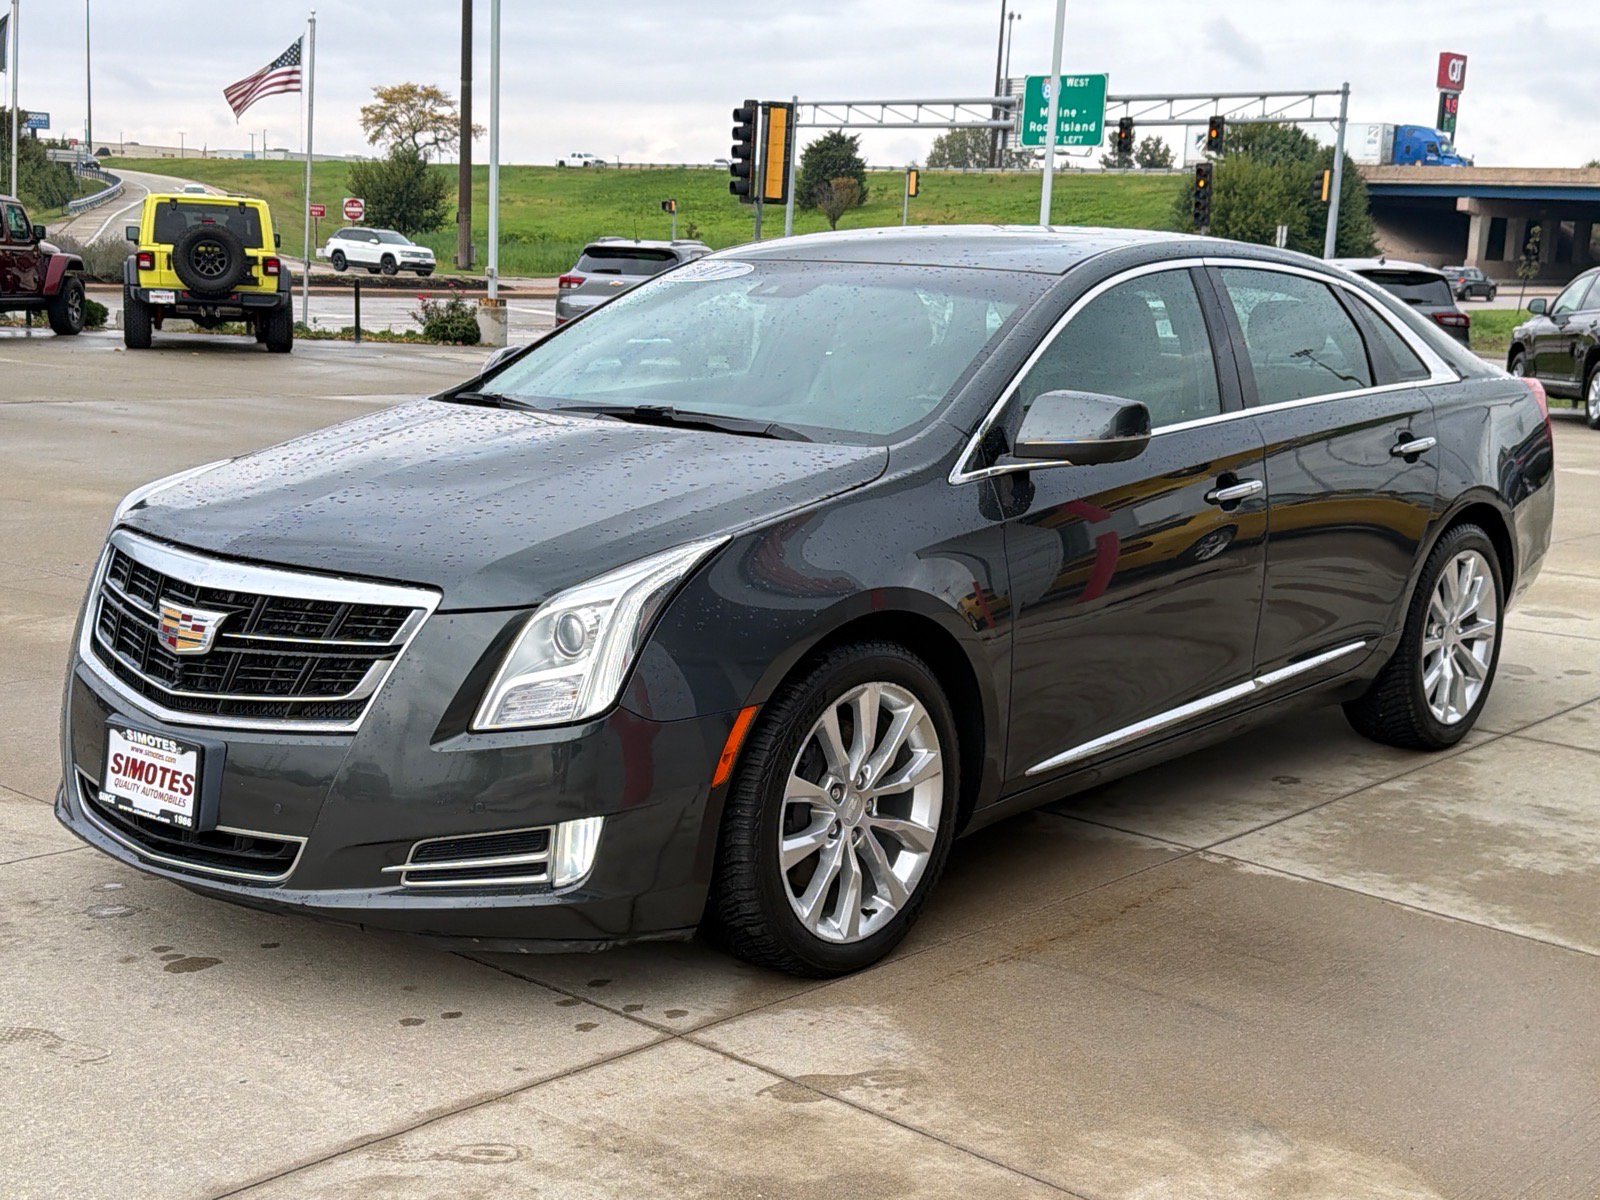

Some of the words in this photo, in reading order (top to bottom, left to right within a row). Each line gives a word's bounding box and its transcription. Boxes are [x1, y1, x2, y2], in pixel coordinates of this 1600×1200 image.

[1448, 59, 1464, 83] QT
[1066, 78, 1089, 87] WEST
[1040, 107, 1077, 117] Mine
[1029, 122, 1053, 132] Roc
[1060, 121, 1096, 132] Island
[1039, 135, 1060, 144] NT
[1063, 135, 1083, 144] LEFT
[126, 729, 177, 753] SIMOTES
[130, 745, 177, 764] www.simotes.com
[110, 752, 195, 796] SIMOTES
[99, 791, 116, 804] SINCE
[114, 777, 141, 793] QUALITY
[141, 786, 187, 808] AUTOMOBILES
